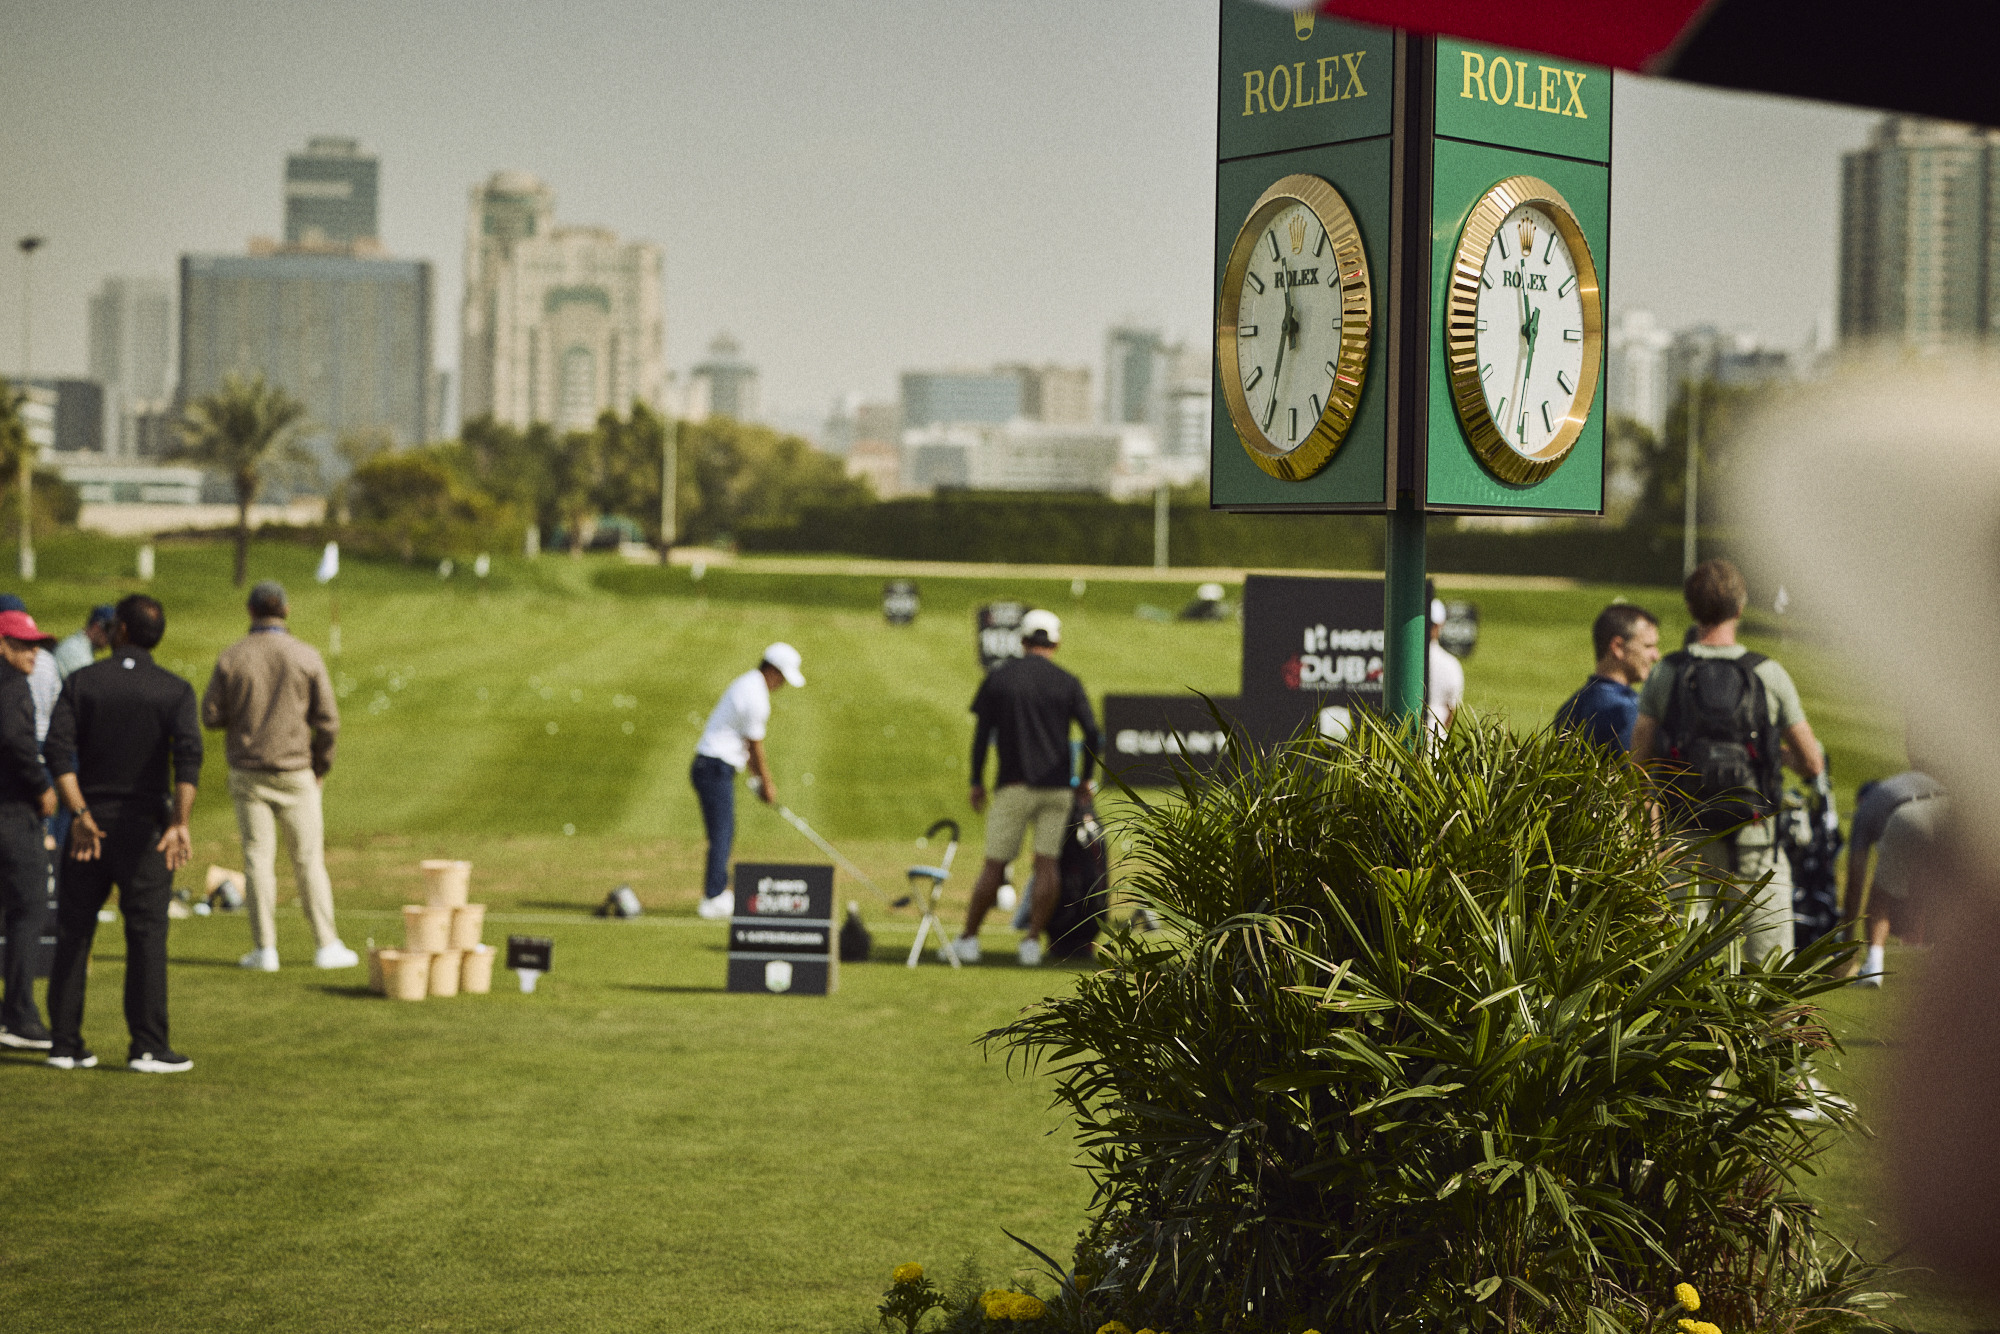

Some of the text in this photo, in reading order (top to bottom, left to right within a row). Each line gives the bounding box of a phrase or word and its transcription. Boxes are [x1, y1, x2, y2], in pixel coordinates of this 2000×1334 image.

[1242, 51, 1367, 116] ROLEX
[1460, 51, 1588, 119] ROLEX
[1300, 655, 1384, 683] DUBA
